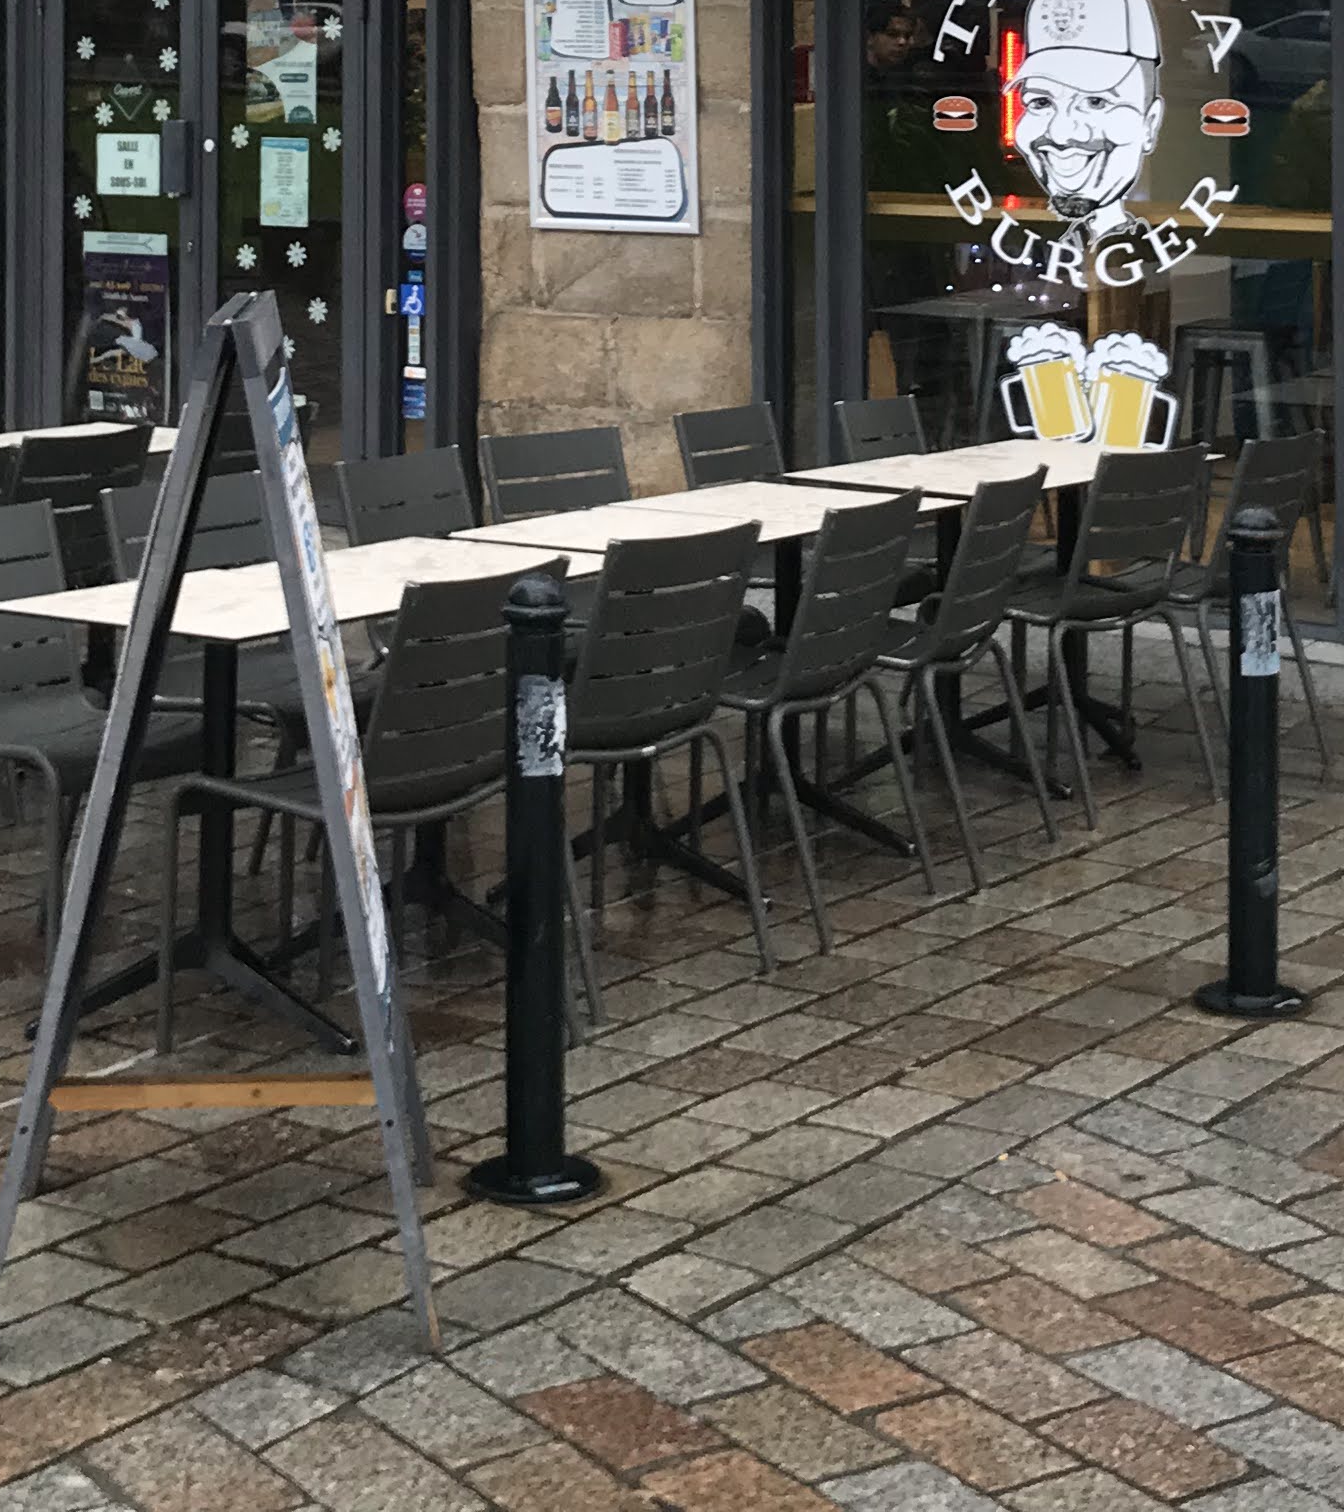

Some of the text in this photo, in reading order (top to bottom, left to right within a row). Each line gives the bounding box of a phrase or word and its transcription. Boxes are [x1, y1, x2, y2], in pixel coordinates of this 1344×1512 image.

[117, 140, 139, 152] SALLE
[123, 159, 135, 170] EN
[945, 167, 1240, 290] BURGER
